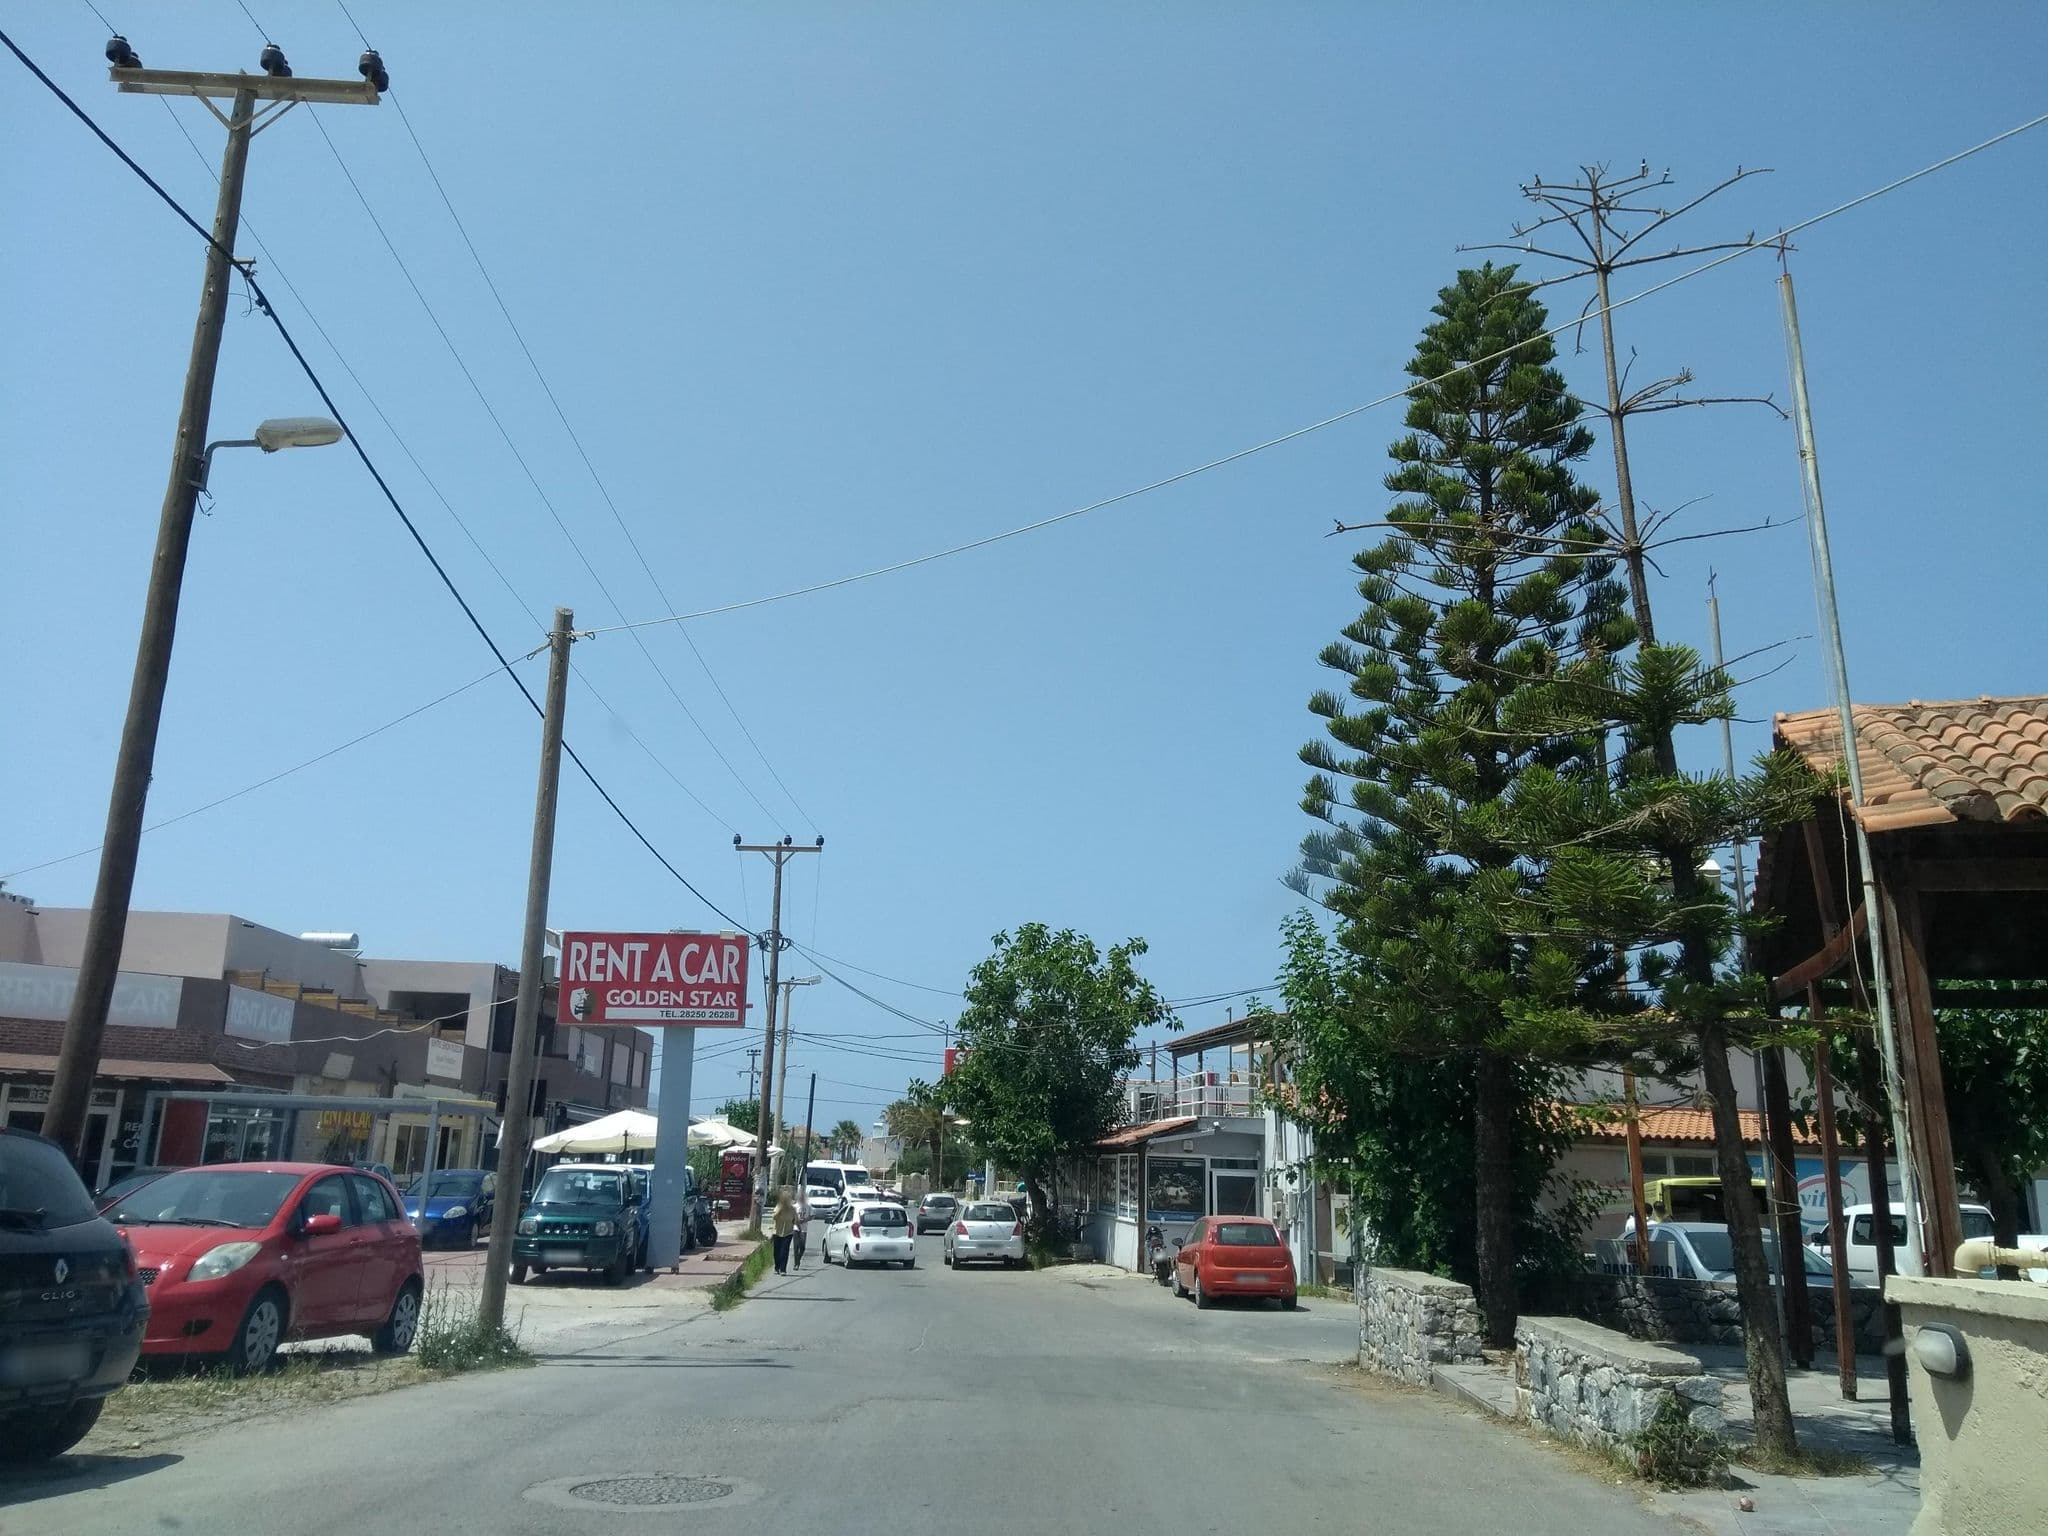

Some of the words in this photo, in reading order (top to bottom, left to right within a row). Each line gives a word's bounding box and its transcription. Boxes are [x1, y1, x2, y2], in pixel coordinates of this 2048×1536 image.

[568, 941, 649, 982] RENT
[651, 943, 674, 983] A
[679, 942, 741, 985] CAR
[606, 989, 684, 1006] GOLDEN
[690, 990, 737, 1007] STAR
[660, 1010, 706, 1018] TEL.28250
[41, 1290, 76, 1301] CLIO
